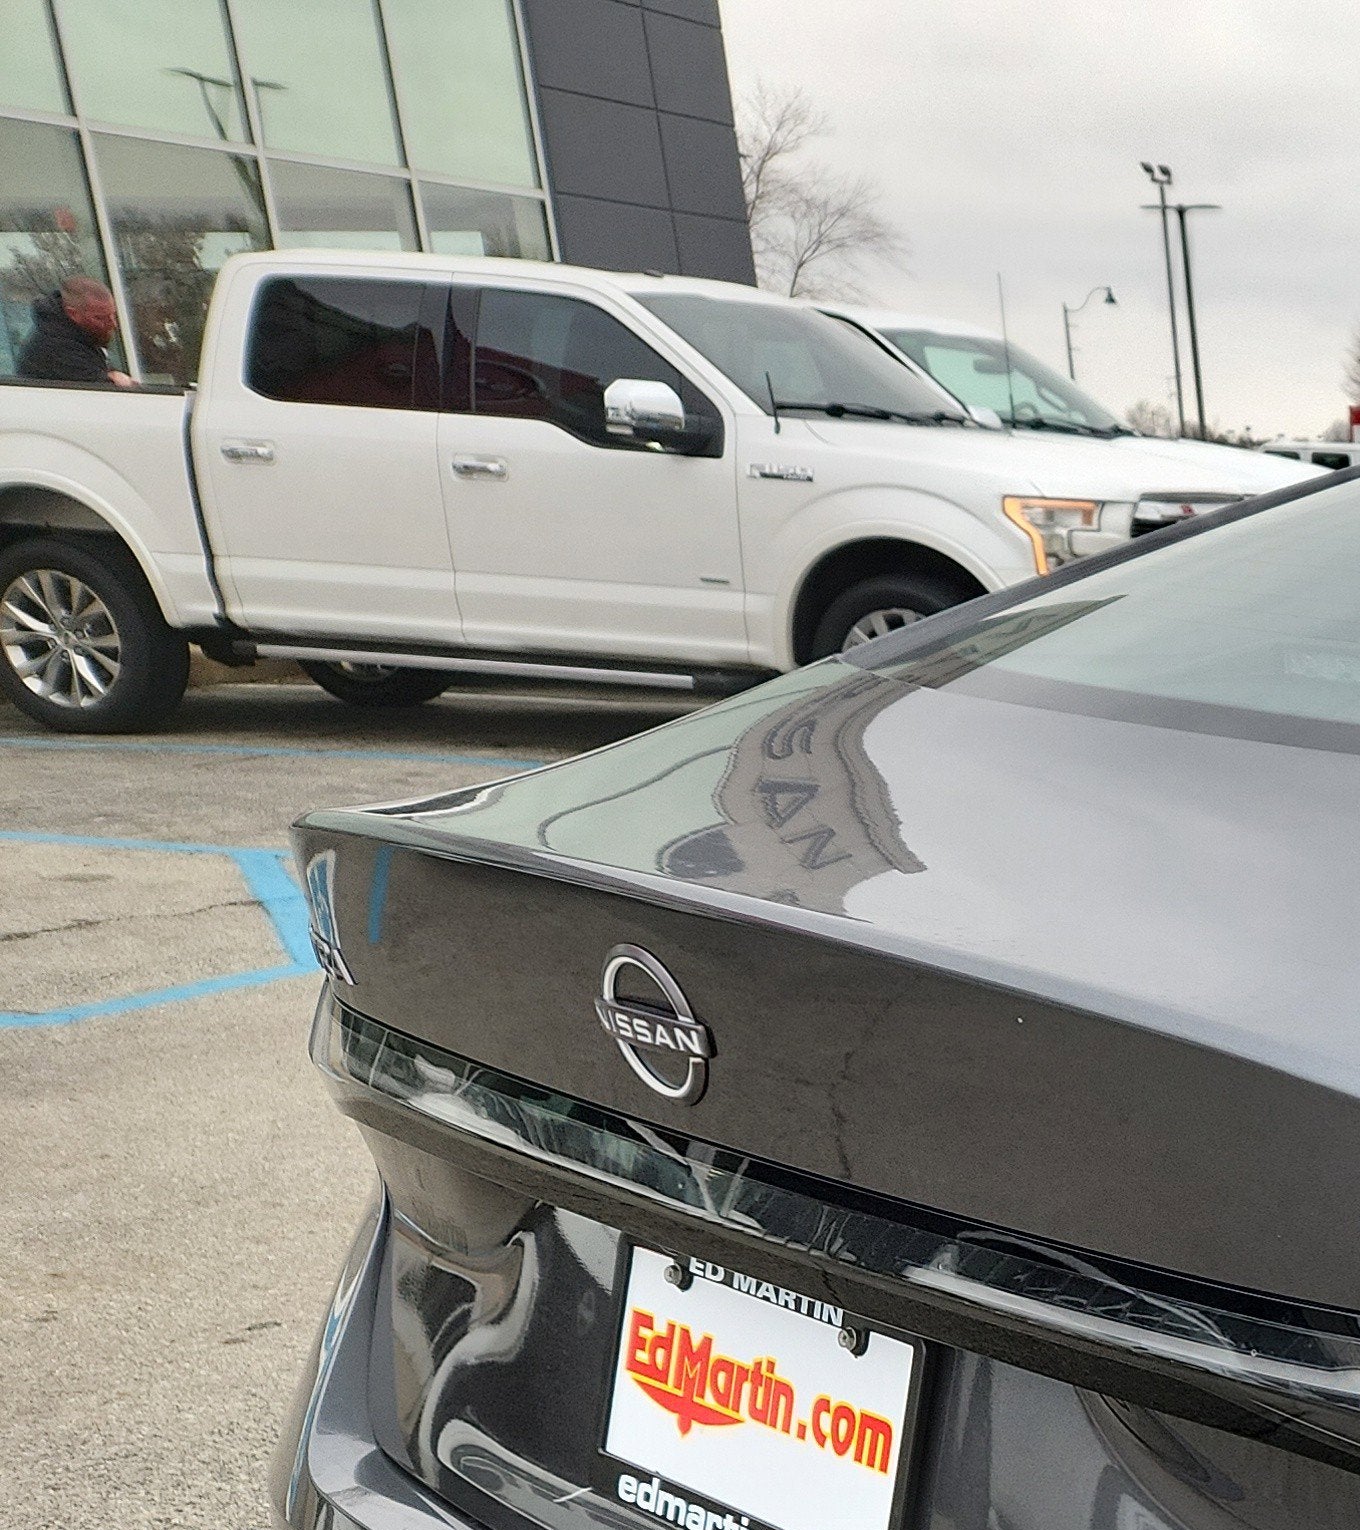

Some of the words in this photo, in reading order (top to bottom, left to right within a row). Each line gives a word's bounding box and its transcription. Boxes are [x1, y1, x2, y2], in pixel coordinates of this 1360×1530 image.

[594, 1003, 703, 1056] NISSAN
[688, 1257, 726, 1282] ED
[731, 1270, 845, 1327] MARTIN
[625, 1306, 894, 1475] EdMartin.com
